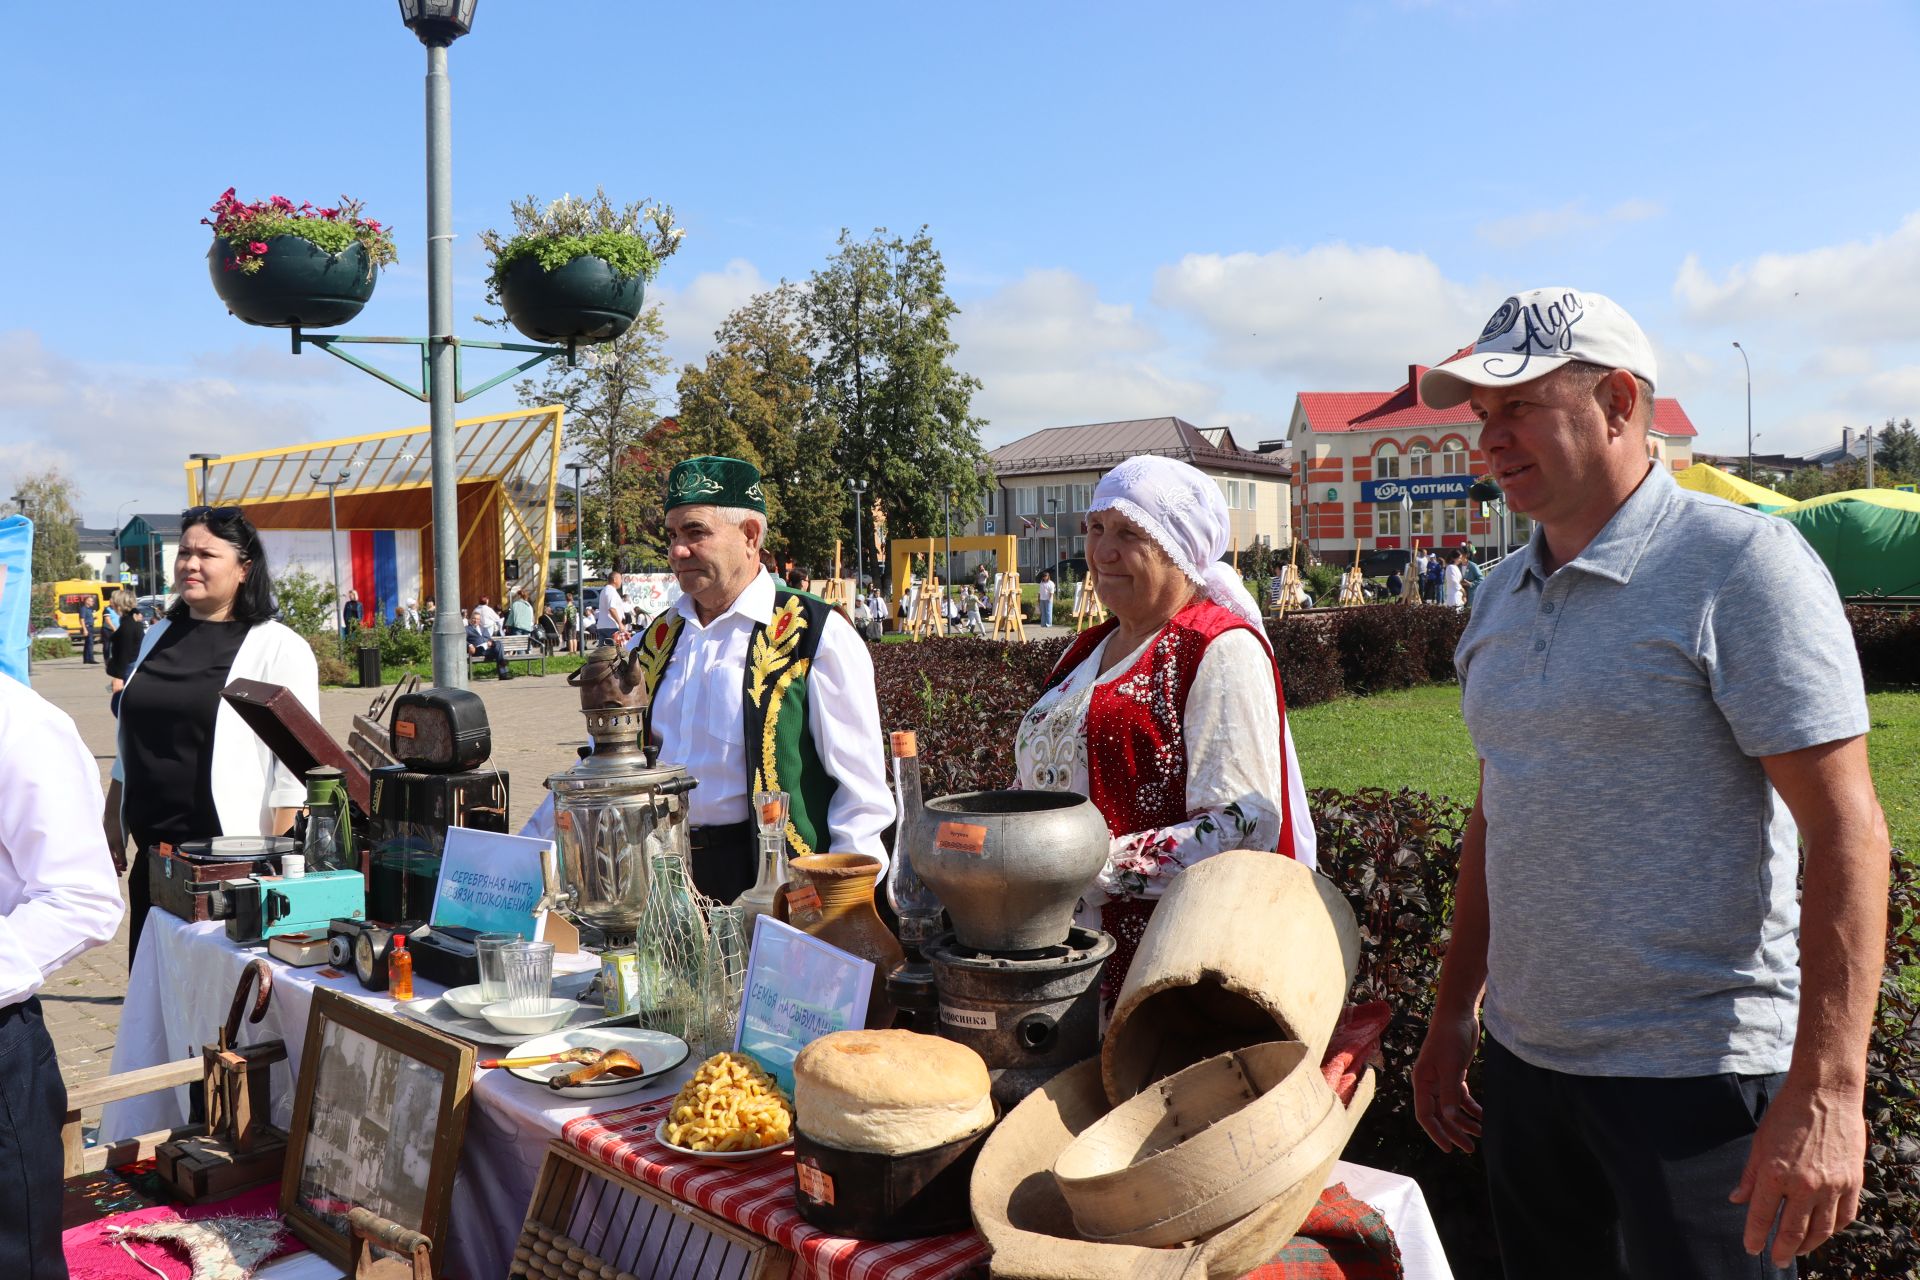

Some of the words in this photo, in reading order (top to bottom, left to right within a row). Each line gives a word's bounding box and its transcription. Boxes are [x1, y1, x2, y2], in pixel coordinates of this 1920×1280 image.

[1483, 290, 1583, 379] Alga
[1374, 483, 1407, 499] КОРД
[1411, 483, 1465, 494] ОПТИКА
[451, 870, 507, 890] СЕРЕБРЯНАЯ
[508, 880, 533, 897] НИТЬ
[475, 892, 533, 913] ПОКОЛЕНИЙ
[751, 983, 778, 1009] СЕМЬЯ
